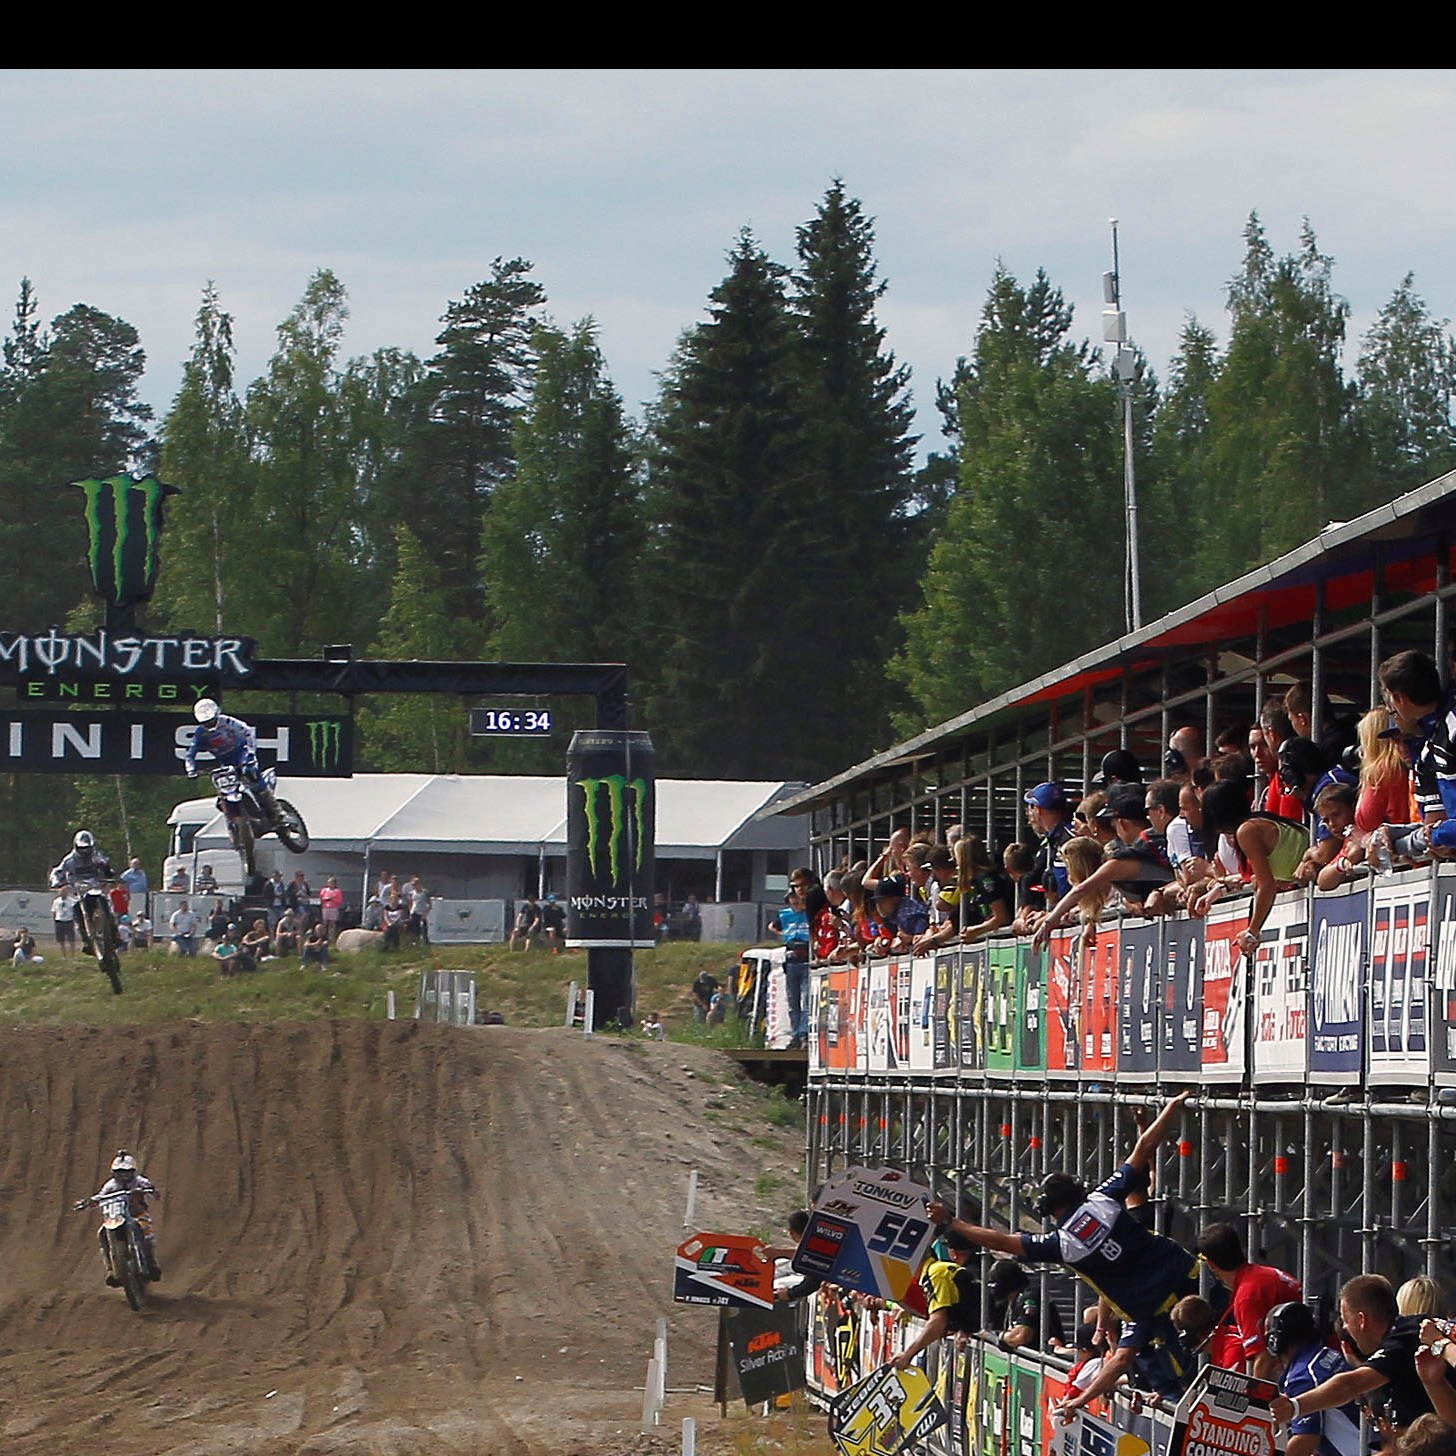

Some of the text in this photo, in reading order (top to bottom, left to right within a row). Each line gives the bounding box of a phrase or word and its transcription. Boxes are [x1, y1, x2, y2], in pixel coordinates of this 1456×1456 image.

[27, 681, 210, 700] ENERGY
[485, 711, 551, 731] 16:34
[570, 895, 649, 911] MONSTER
[854, 1180, 921, 1208] TONKOV
[866, 1210, 931, 1261] 59
[866, 1374, 907, 1432] 33
[1189, 1409, 1263, 1456] STANDING
